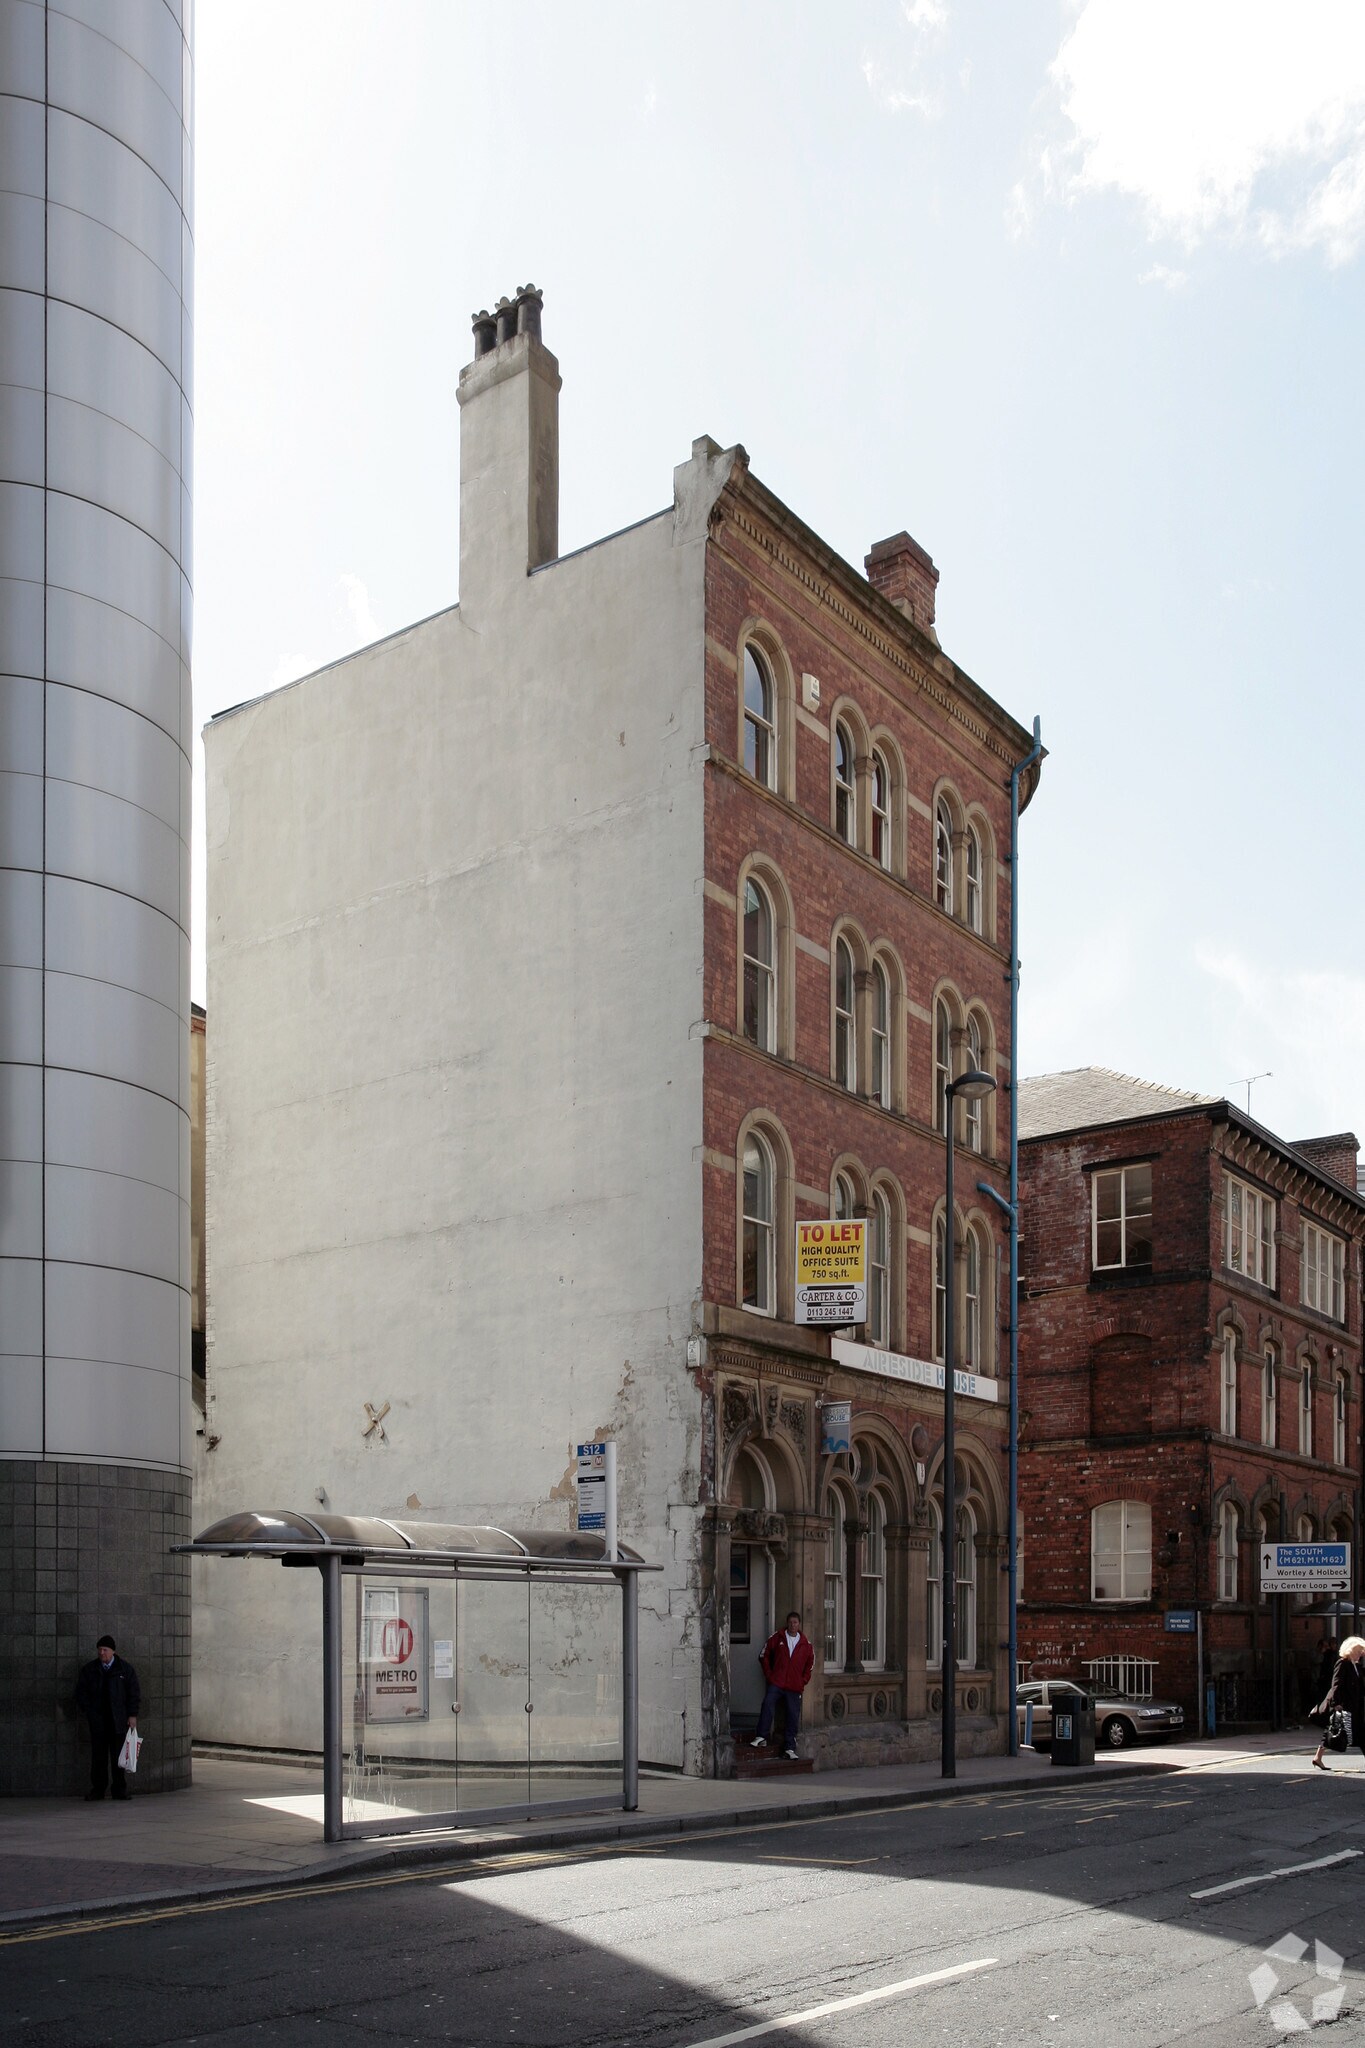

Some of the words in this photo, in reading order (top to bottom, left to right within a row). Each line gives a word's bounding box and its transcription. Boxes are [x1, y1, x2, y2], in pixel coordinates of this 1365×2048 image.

[800, 1225, 824, 1242] TO
[830, 1224, 863, 1241] LET
[801, 1246, 822, 1255] HIGH
[825, 1245, 861, 1255] QUALITY
[802, 1258, 832, 1267] OFFICE
[835, 1257, 859, 1266] SUITE
[811, 1270, 826, 1278] 750
[801, 1292, 835, 1301] CARTER
[836, 1292, 843, 1300] &
[845, 1291, 860, 1300] CO.
[807, 1308, 823, 1317] 0113
[825, 1307, 837, 1316] 245
[838, 1307, 854, 1315] 1447
[863, 1350, 932, 1383] AIRESIDE
[936, 1367, 976, 1395] HUSE
[825, 1414, 846, 1422] HOUSE
[583, 1445, 600, 1455] S12
[1309, 1582, 1328, 1590] Loop
[1037, 1646, 1062, 1655] UNIT
[1045, 1657, 1070, 1665] ONLY
[375, 1670, 417, 1682] METRO
